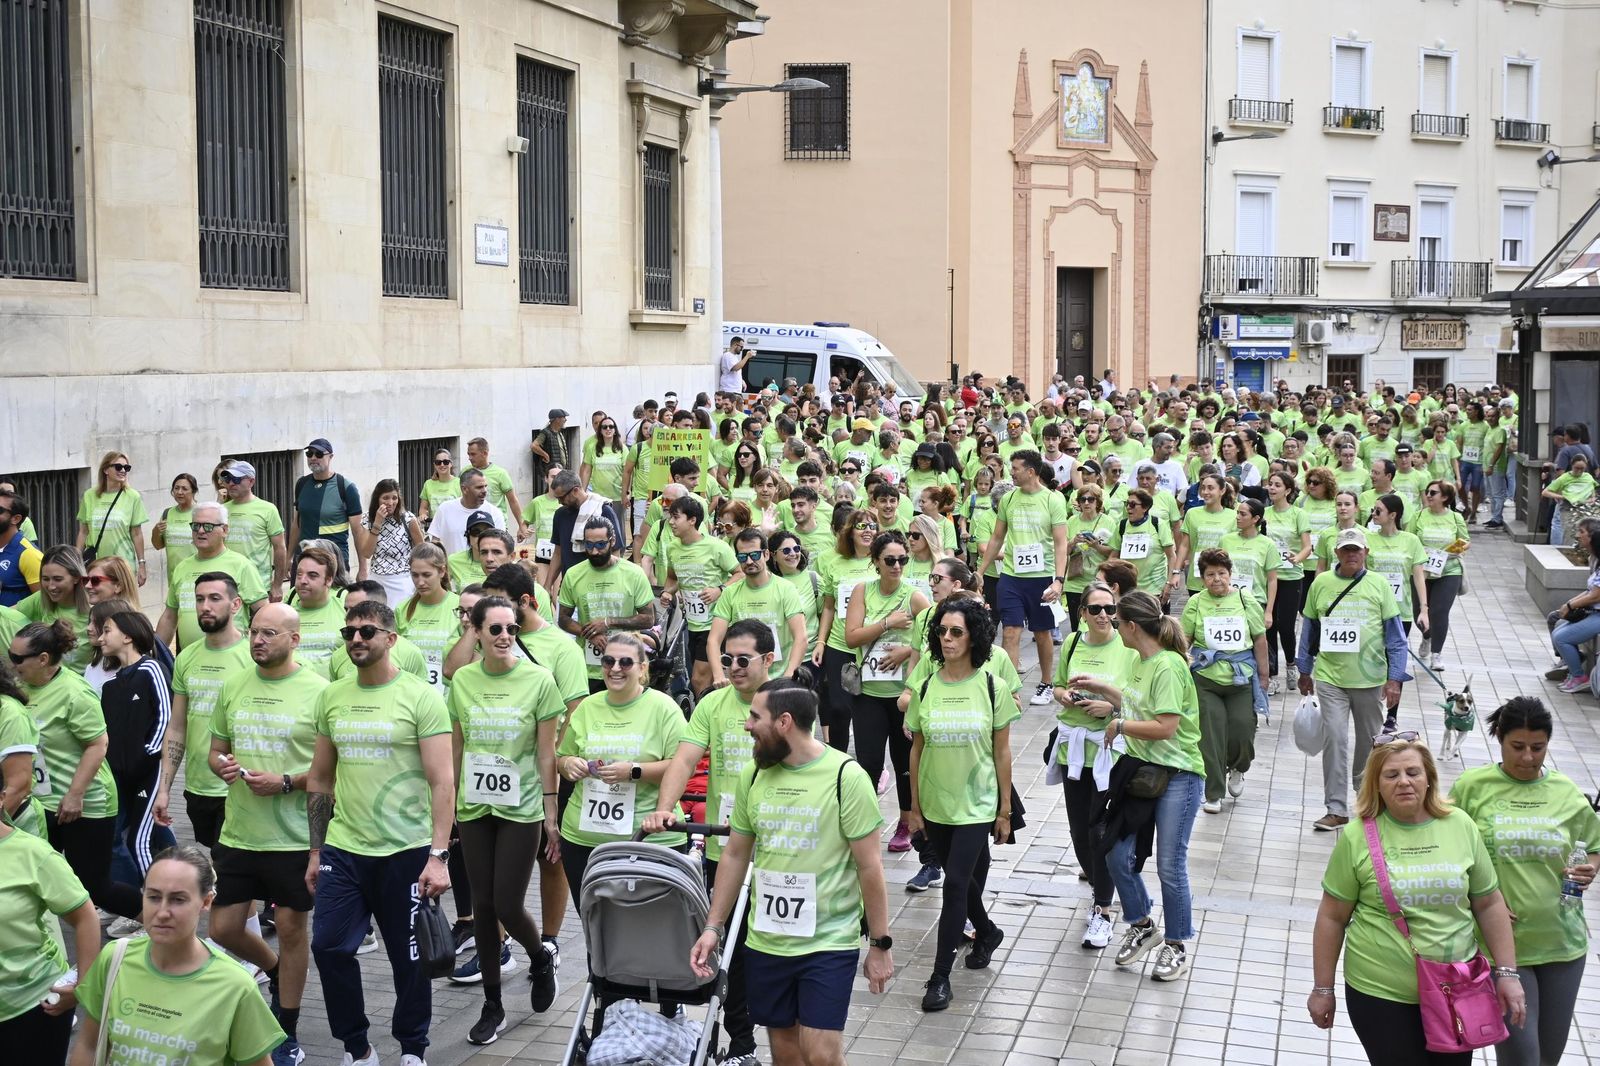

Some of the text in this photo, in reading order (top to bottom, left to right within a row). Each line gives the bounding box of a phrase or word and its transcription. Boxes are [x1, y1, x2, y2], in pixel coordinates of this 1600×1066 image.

[776, 328, 820, 338] CIVIL
[1410, 323, 1457, 340] LA TRAVIESA
[1578, 330, 1600, 346] BUR
[541, 548, 552, 557] 11
[1018, 554, 1038, 566] 251
[236, 710, 295, 724] En marcha
[470, 717, 519, 726] contra el
[234, 724, 276, 736] contra
[335, 719, 393, 730] En marcha
[929, 720, 981, 730] contra el
[334, 733, 391, 744] contra el
[470, 727, 521, 741] cáncer
[932, 729, 981, 742] cáncer
[235, 735, 289, 752] cáncer
[337, 745, 393, 758] cáncer
[585, 746, 640, 755] contra el
[716, 733, 724, 776] HUELVA
[473, 772, 511, 792] 708
[588, 799, 624, 820] 706
[759, 802, 821, 817] En marcha
[759, 817, 817, 833] contra el
[1495, 814, 1512, 825] En
[1496, 828, 1550, 840] contra
[762, 832, 819, 850] cáncer
[1498, 840, 1563, 857] cáncer
[1408, 861, 1462, 872] marcha
[1390, 876, 1463, 889] contra el
[763, 894, 805, 919] 707
[113, 1019, 197, 1052] En marcha
[112, 1041, 166, 1066] contra
